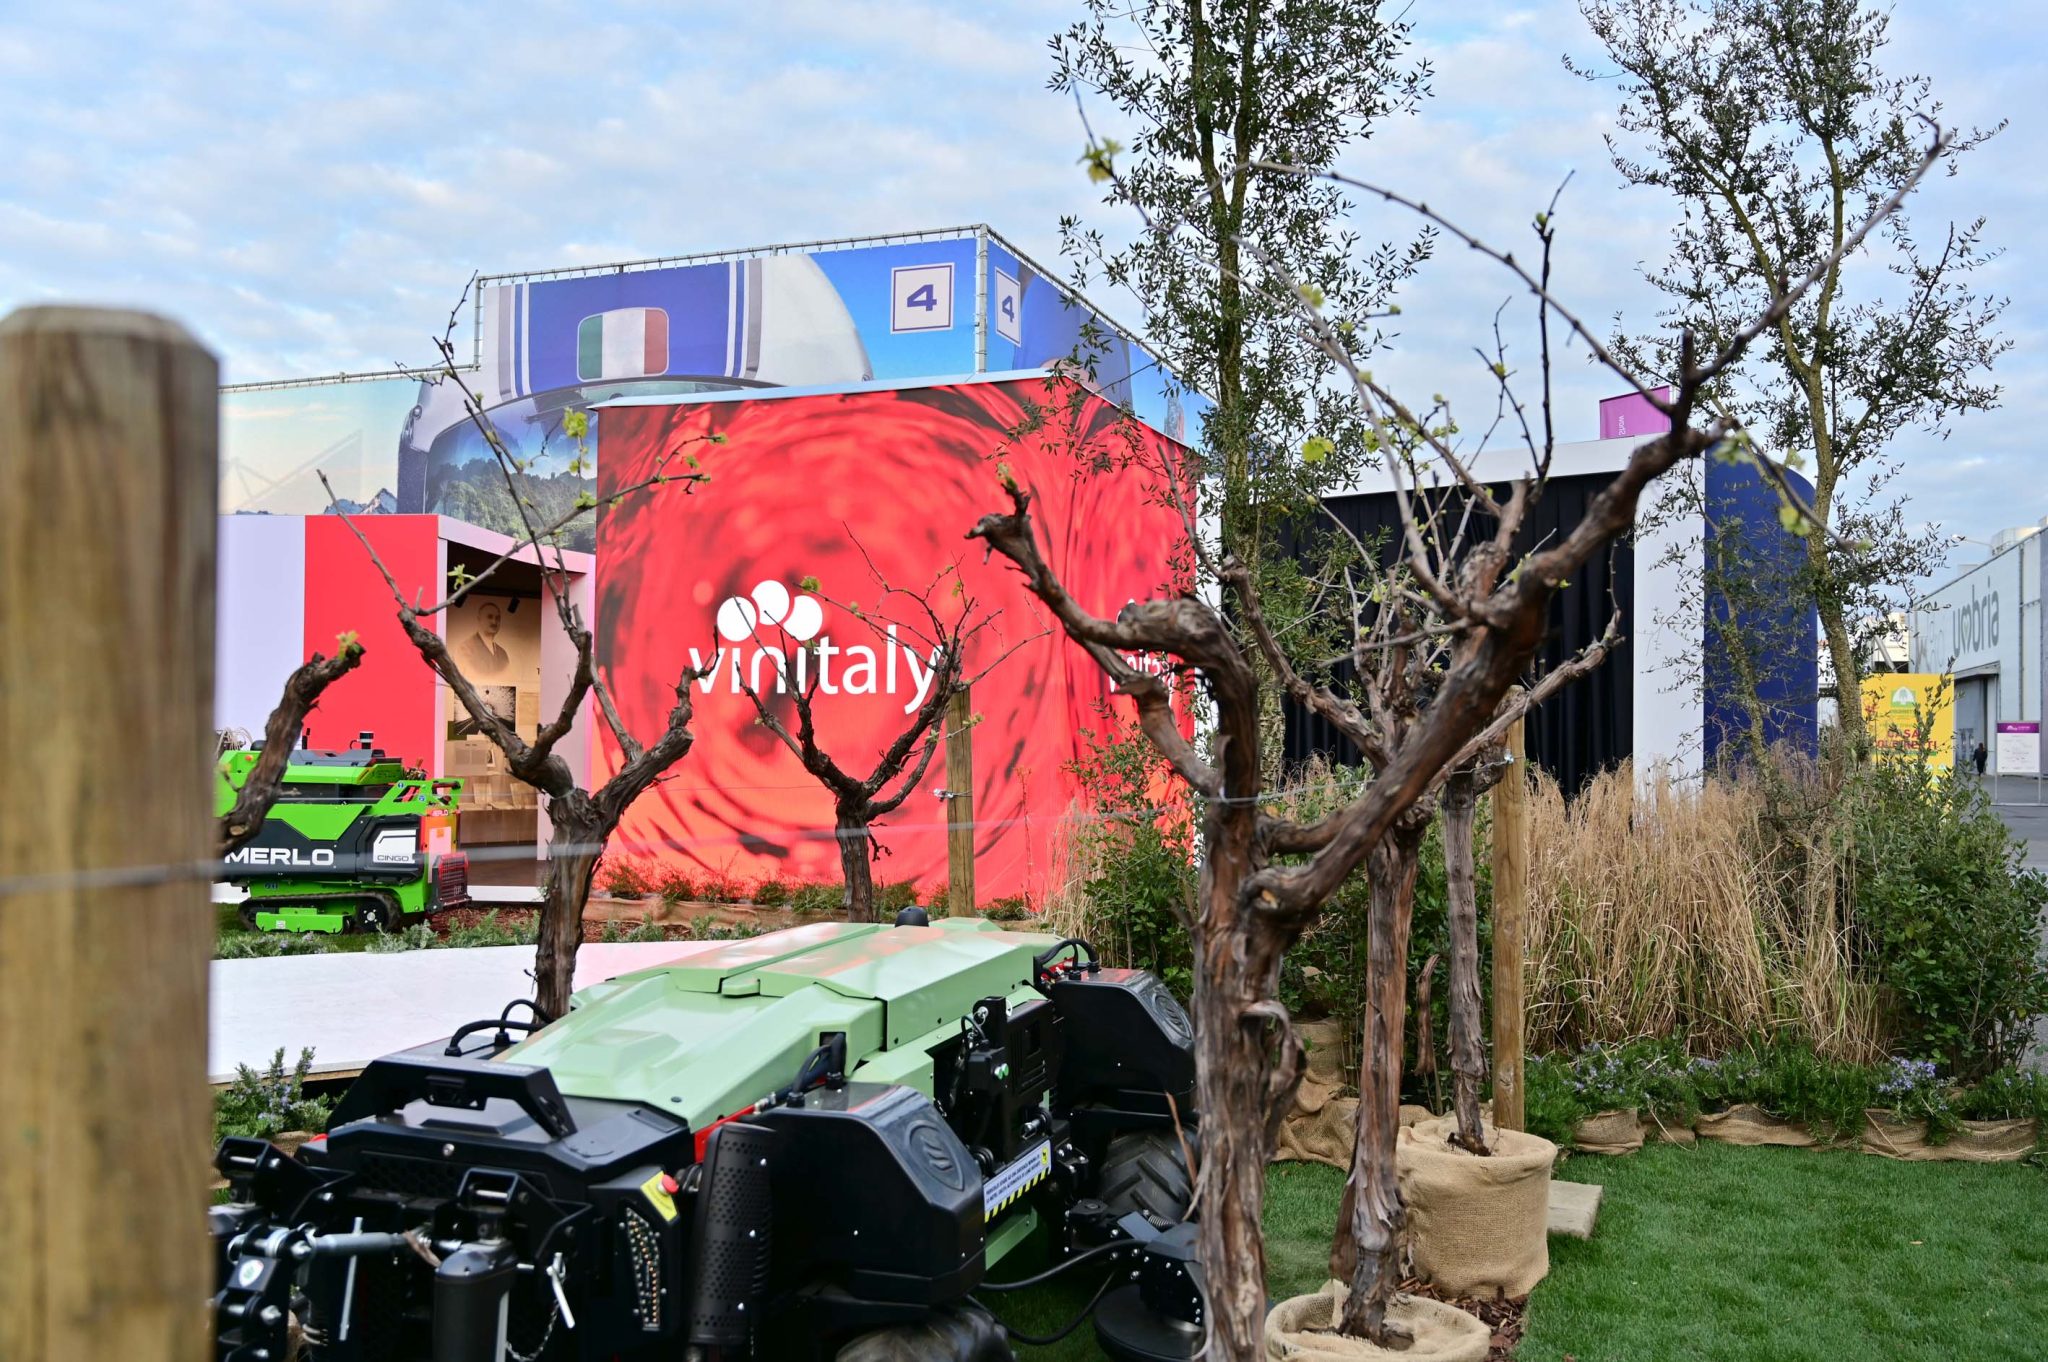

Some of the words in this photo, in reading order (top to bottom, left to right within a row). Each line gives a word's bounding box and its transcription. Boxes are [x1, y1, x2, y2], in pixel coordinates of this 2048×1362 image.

[907, 284, 937, 311] 4
[1002, 295, 1014, 323] 4
[1953, 576, 1999, 657] umbria
[688, 624, 944, 715] vinitaly
[1887, 729, 1920, 738] CSA
[224, 847, 334, 866] MERLO
[377, 854, 410, 862] CINGO
